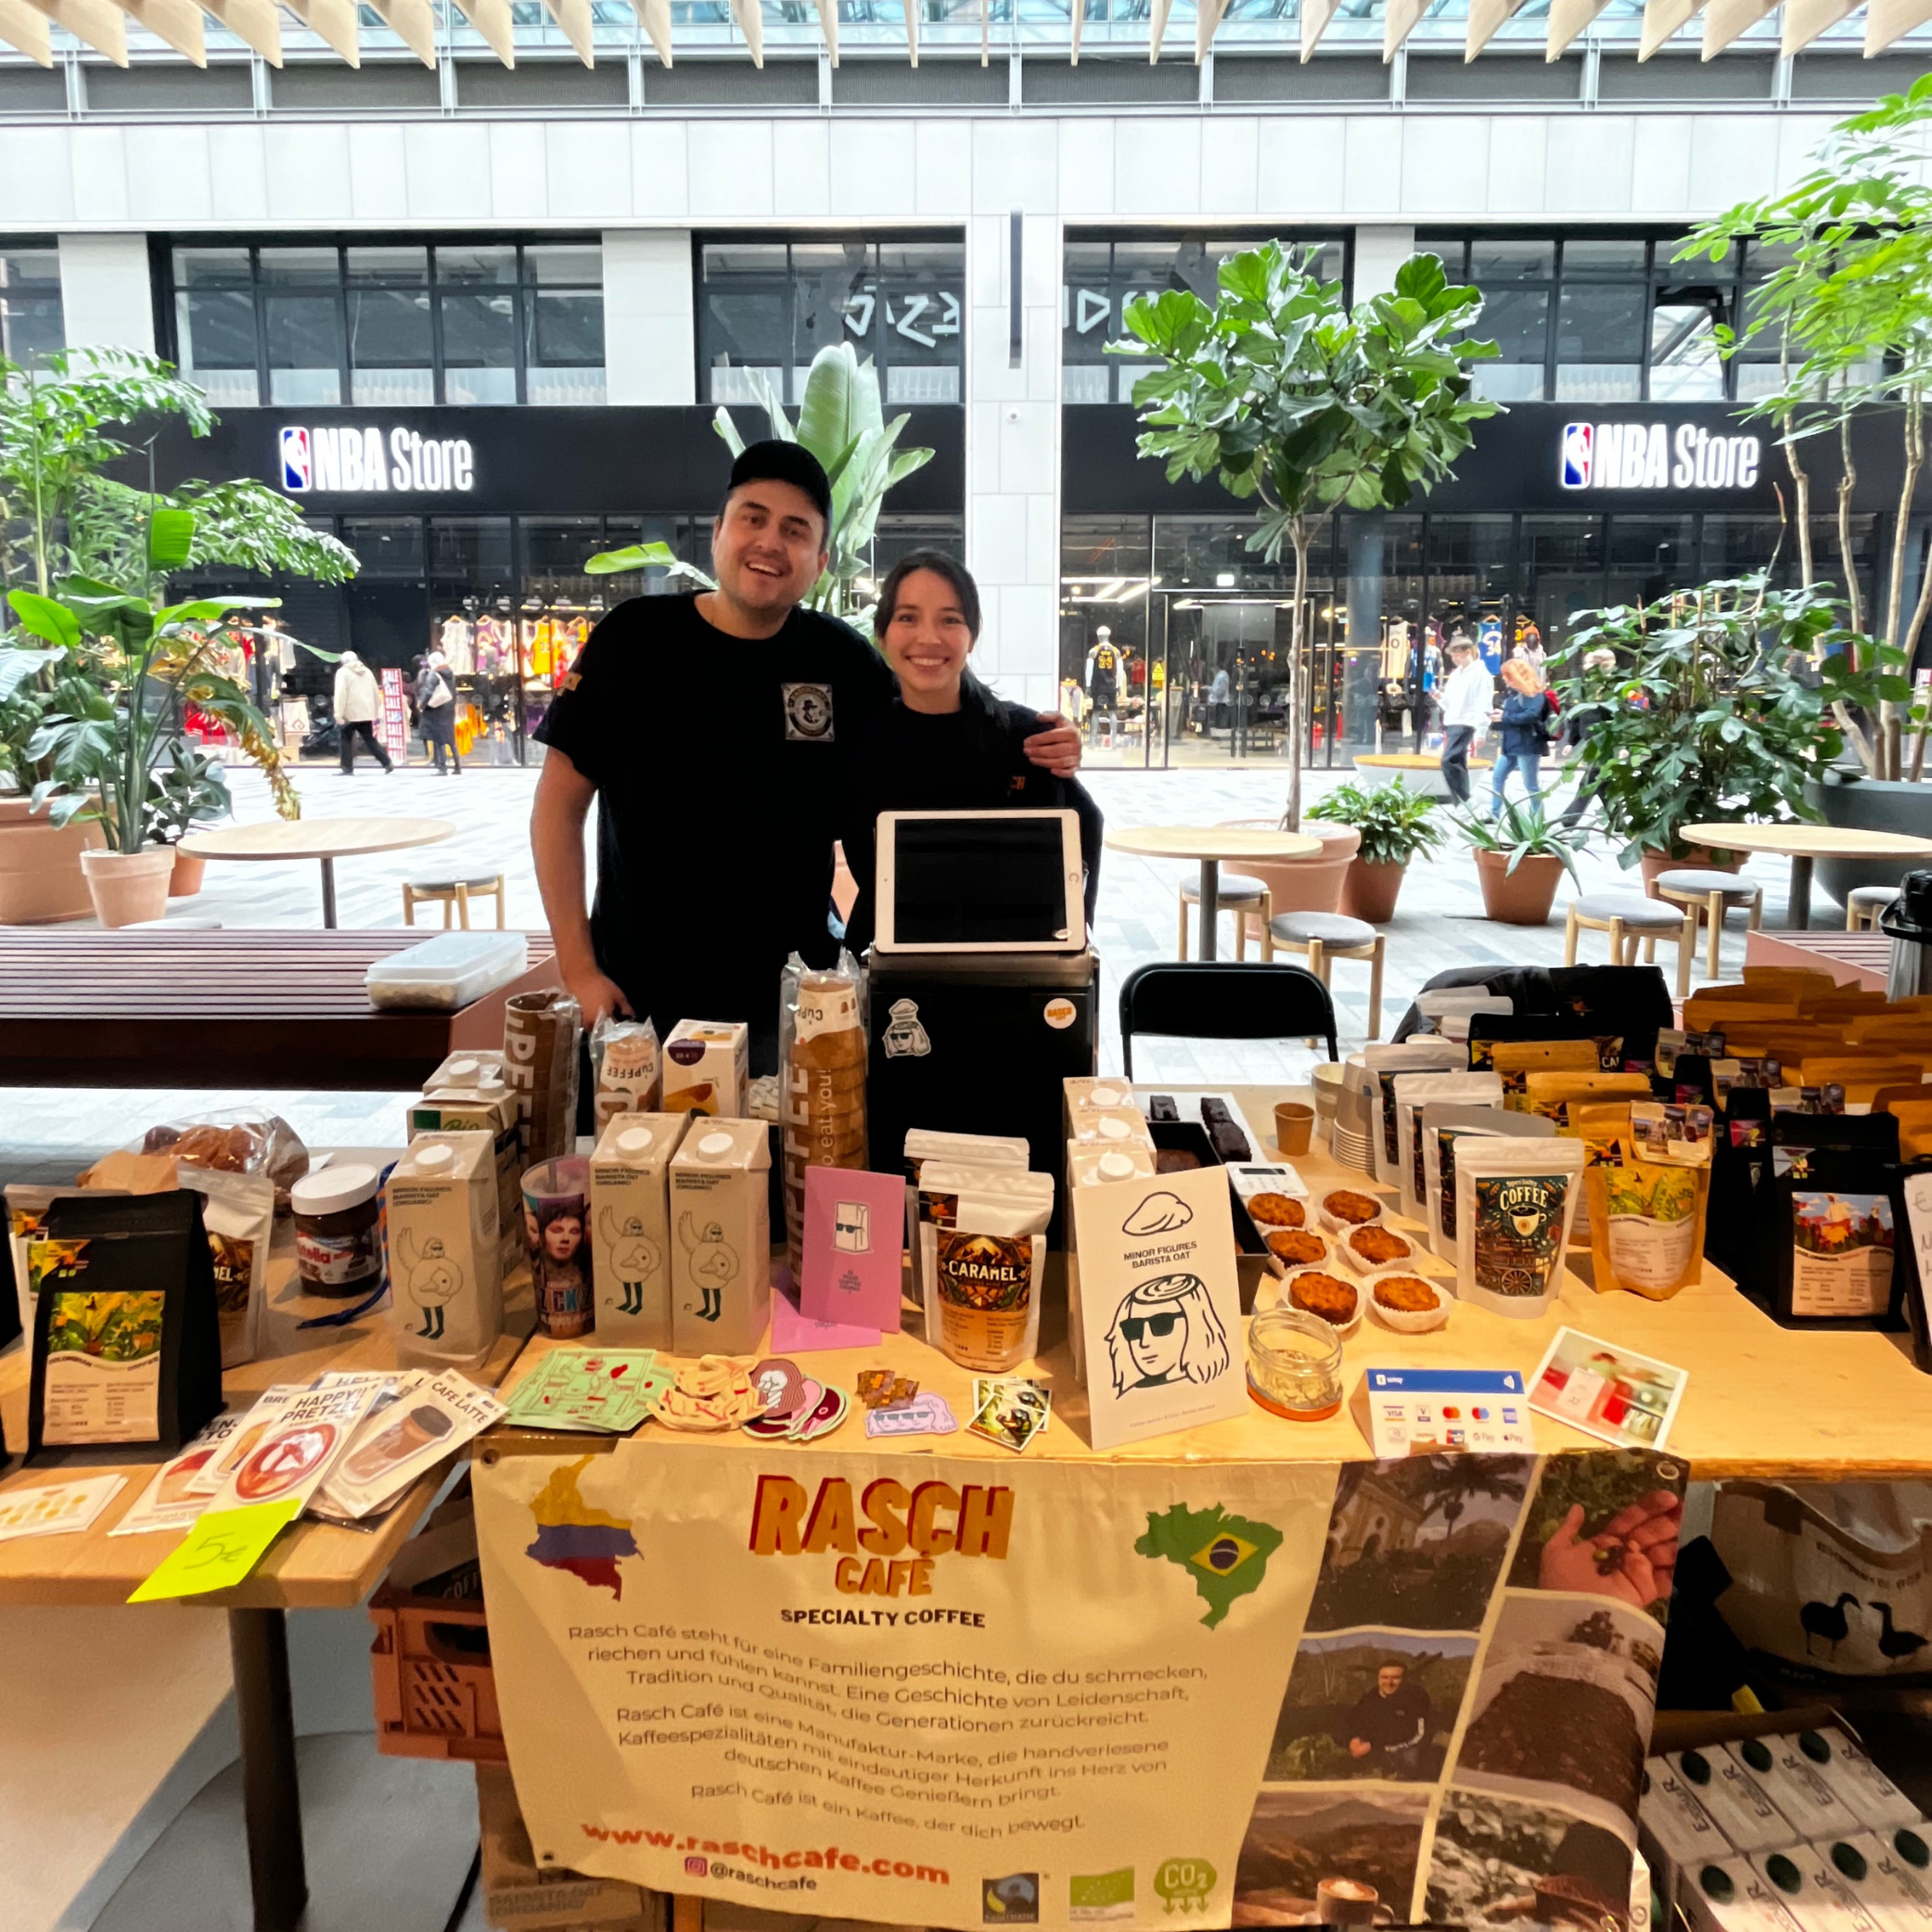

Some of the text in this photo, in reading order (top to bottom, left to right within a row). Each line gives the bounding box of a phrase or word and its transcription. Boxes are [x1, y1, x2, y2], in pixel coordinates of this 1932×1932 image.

[313, 427, 473, 492] NBA Store
[1594, 423, 1759, 489] NBA Store
[386, 710, 402, 722] SA
[816, 1068, 837, 1114] you!
[817, 1119, 834, 1148] eat
[1500, 1186, 1549, 1210] COFFEE
[949, 1260, 1017, 1282] CARAMEL
[1124, 1240, 1197, 1261] MINOR FIGURES
[1132, 1251, 1192, 1269] BARISTA OAT
[280, 1400, 361, 1423] PRETZEL
[431, 1381, 458, 1402] CAFE
[454, 1398, 489, 1424] LATTE
[749, 1475, 1015, 1560] RASCH
[835, 1550, 936, 1597] CAFÉ
[781, 1609, 985, 1628] SPECIALTY COFFEE
[569, 1624, 1208, 1686] Rasch Café steht für eine Familiengeschichte, die du schmecken,
[588, 1646, 660, 1662] riechen
[666, 1647, 705, 1662] und
[710, 1649, 768, 1678] fühlen
[847, 1685, 889, 1703] Eine
[895, 1686, 1008, 1709] Geschichte
[1013, 1695, 1050, 1709] von
[1056, 1686, 1189, 1708] Leidenschaft,
[626, 1670, 1149, 1734] Tradition und Qualität, die Generationen zurückreicht.
[617, 1702, 1170, 1769] Rasch Café ist eine Manufaktur-Marke, die handverlesene
[619, 1724, 1167, 1788] Kaffeespezialitäten mit eindeutiger Herkunft ins Herz von
[724, 1747, 823, 1778] deutschen
[827, 1768, 885, 1796] Kaffee
[890, 1785, 992, 1809] Genießern
[691, 1782, 747, 1798] Rasch
[751, 1788, 793, 1806] Café
[799, 1790, 817, 1807] ist
[823, 1801, 851, 1817] ein
[856, 1807, 920, 1829] Kaffee,
[924, 1818, 955, 1832] der
[961, 1823, 1003, 1839] dich
[580, 1823, 950, 1886] www.raschcafe.com
[710, 1861, 818, 1891] @raschcafe
